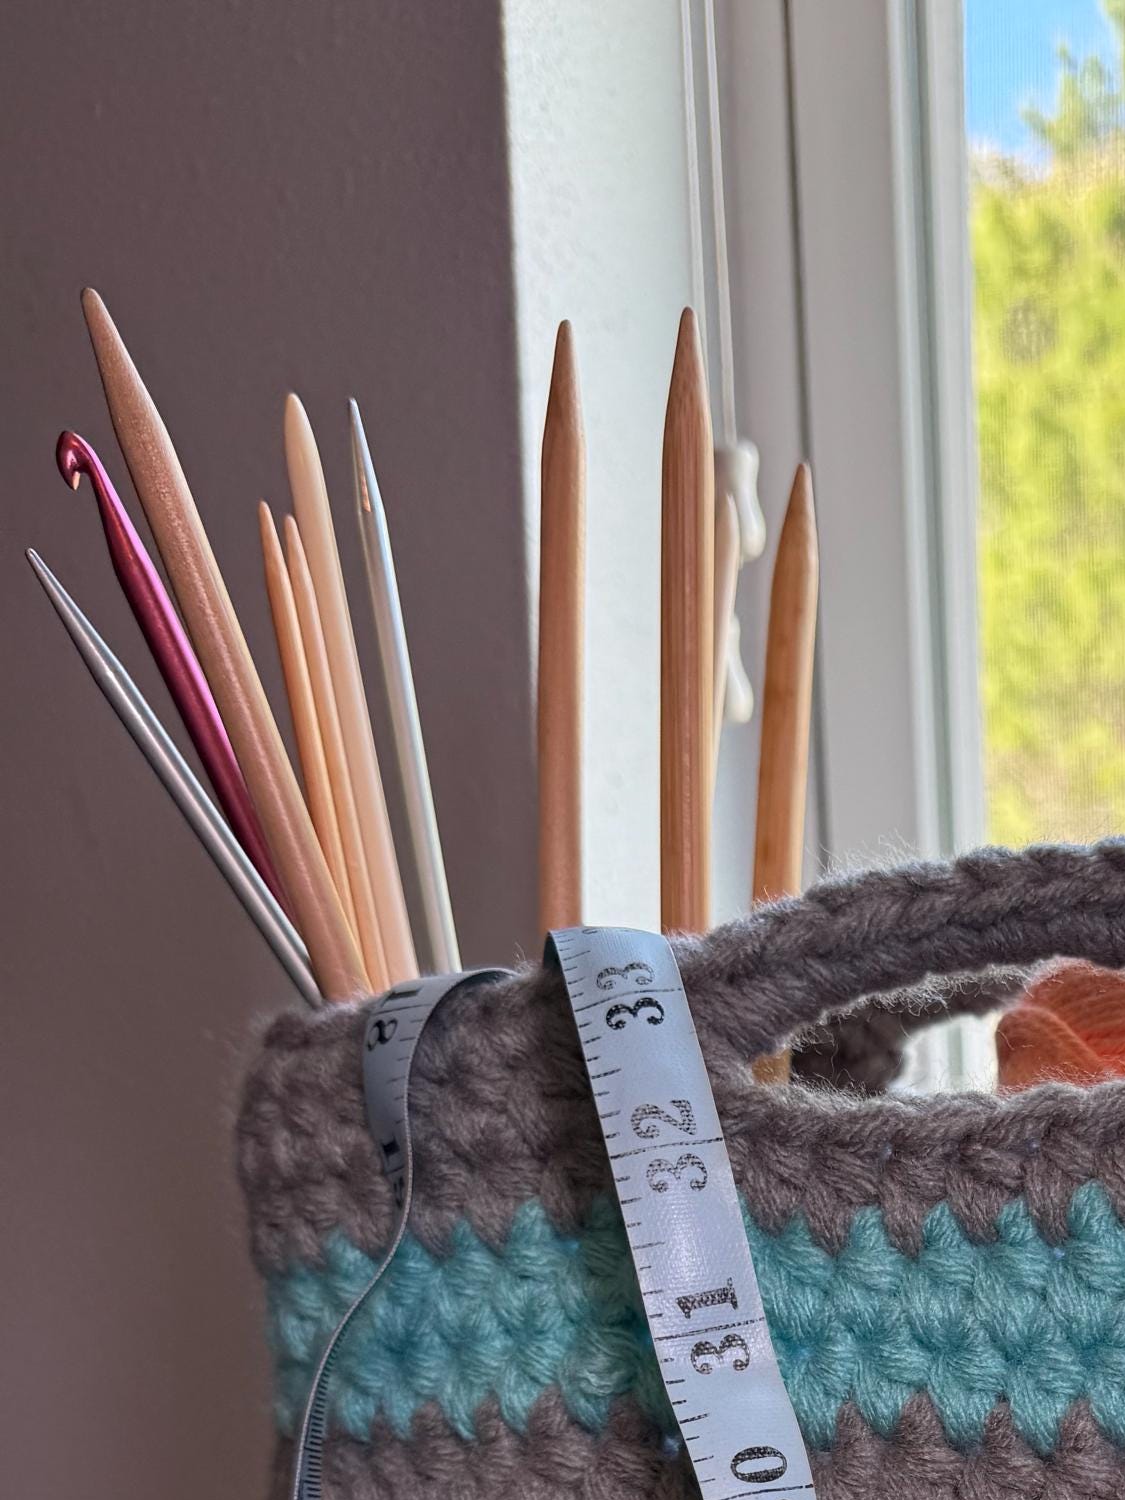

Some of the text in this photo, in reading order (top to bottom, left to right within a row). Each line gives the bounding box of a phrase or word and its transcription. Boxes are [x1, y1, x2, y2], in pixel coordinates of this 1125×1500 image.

[596, 962, 665, 1031] 33
[630, 1099, 709, 1193] 32
[676, 1276, 750, 1375] 31
